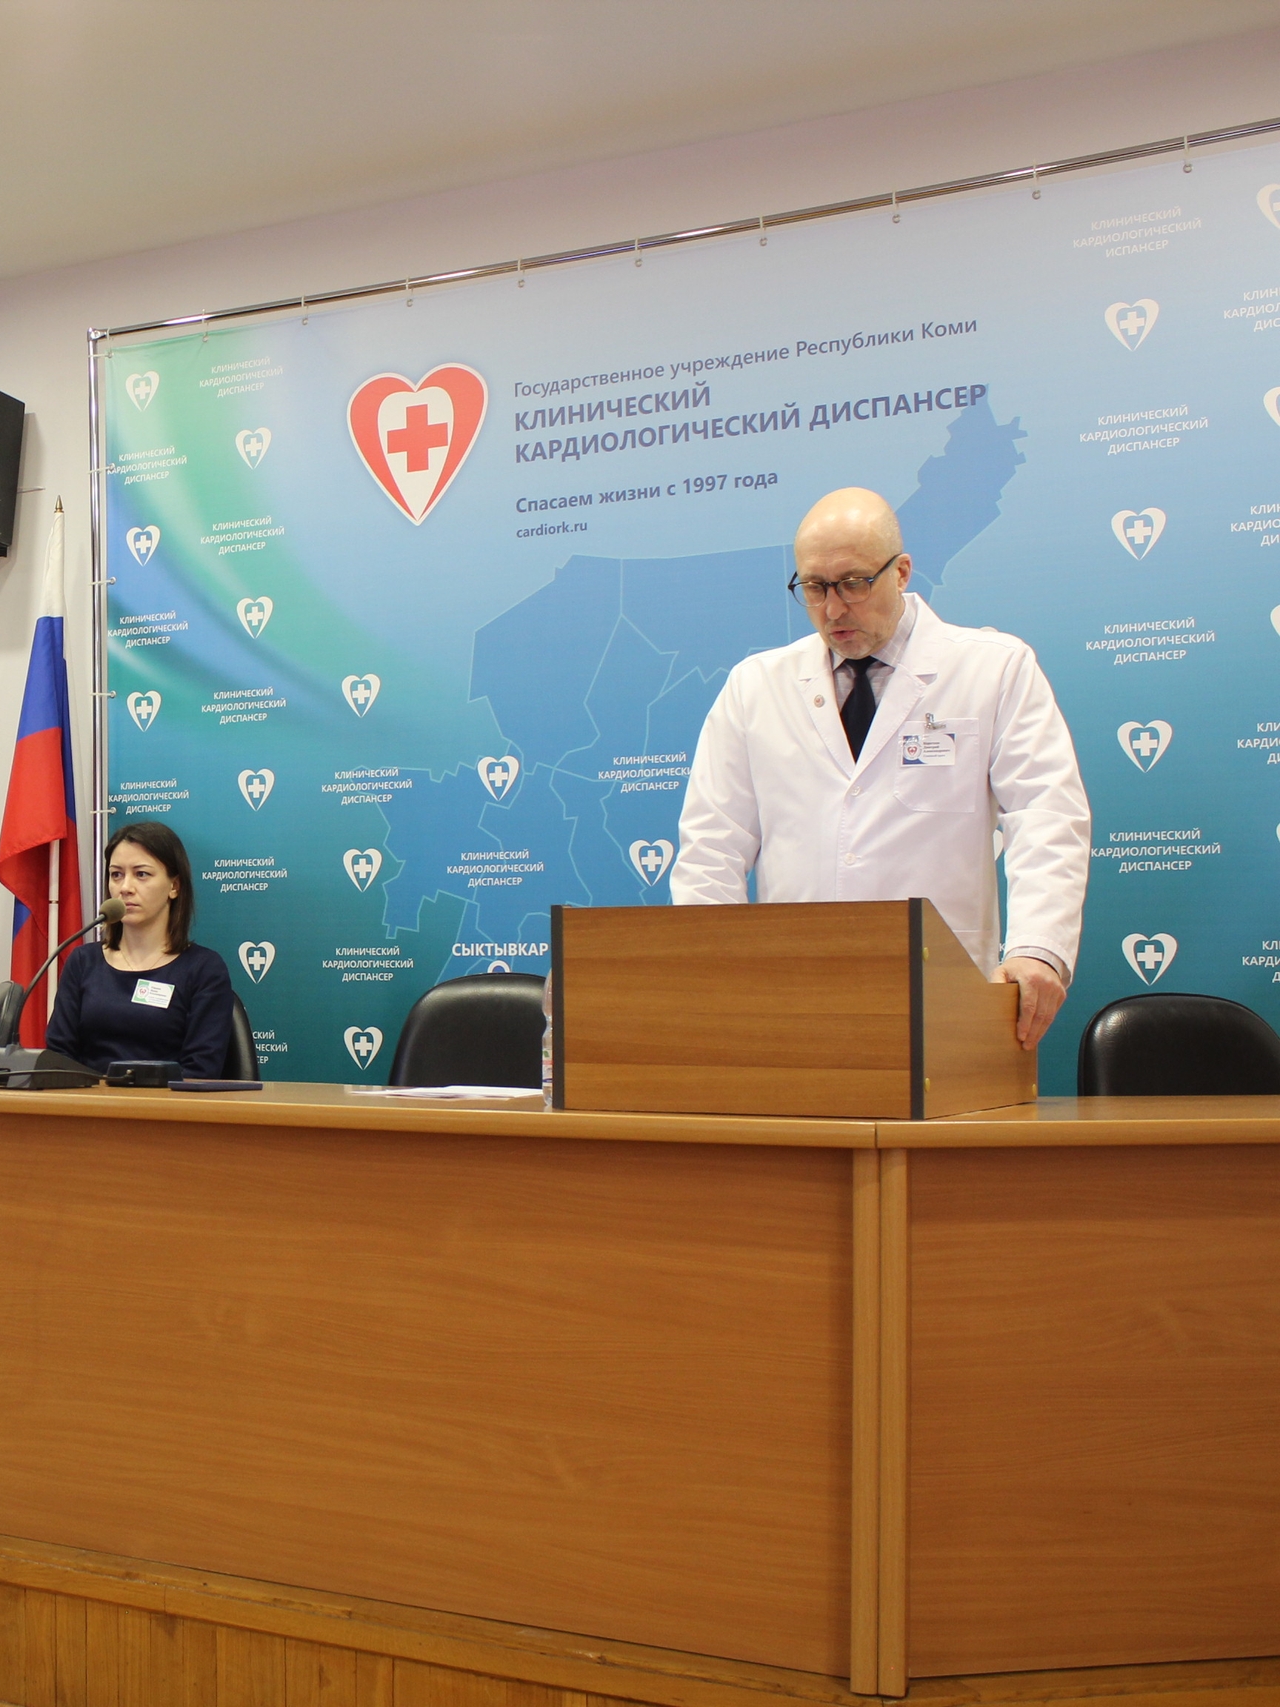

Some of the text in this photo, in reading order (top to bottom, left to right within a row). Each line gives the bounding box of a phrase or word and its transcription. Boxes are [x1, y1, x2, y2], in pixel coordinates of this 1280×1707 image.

[1091, 206, 1181, 230] КЛИНИЧЕСКИЙ
[1073, 218, 1202, 248] КАРДИОЛОГИЧЕСКИЙ
[514, 318, 977, 397] Государственное учреждение Республики Коми
[211, 357, 270, 374] КЛИНИЧЕСКИЙ
[199, 366, 283, 388] КАРДИОЛОГИЧЕСКИЙ
[217, 382, 264, 398] ДИСПАНСЕР
[515, 383, 710, 432] КЛИНИЧЕСКИЙ
[1098, 405, 1188, 426] КЛИНИЧЕСКИЙ
[515, 383, 987, 464] КАРДИОЛОГИЧЕСКИЙ ДИСПАНСЕР
[1079, 417, 1208, 442] КАРДИОЛОГИЧЕСКИЙ
[119, 446, 175, 461] КЛИНИЧЕСКИЙ
[1108, 438, 1179, 455] ДИСПАНСЕР
[124, 471, 169, 485] ДИСПАНСЕР
[516, 470, 778, 513] Спасаем жизни с 1997 года
[213, 516, 272, 531] КЛИНИЧЕСКИЙ
[516, 520, 587, 538] cardiork.ru
[200, 526, 284, 545] КАРДИОЛОГИЧЕСКИЙ
[218, 541, 265, 555] ДИСПАНСЕР
[120, 611, 176, 625] КЛИНИЧЕСКИЙ
[108, 621, 188, 637] КАРДИОЛОГИЧЕСКИЙ
[1104, 617, 1194, 634] КЛИНИЧЕСКИЙ
[125, 636, 170, 648] ДИСПАНСЕР
[1086, 631, 1215, 651] КАРДИОЛОГИЧЕСКИЙ
[1114, 650, 1186, 665] ДИСПАНСЕР
[213, 687, 273, 700] КЛИНИЧЕСКИЙ
[201, 698, 286, 714] КАРДИОЛОГИЧЕСКИЙ
[220, 712, 267, 725] ДИСПАНСЕР
[613, 752, 686, 765] КЛИНИЧЕСКИЙ
[334, 768, 398, 780] КЛИНИЧЕСКИЙ
[598, 768, 692, 780] КАРДИОЛОГИЧЕСКИ
[120, 778, 177, 791] КЛИНИЧЕСКИЙ
[322, 779, 412, 793] КАРДИОЛОГИЧЕСКИЙ
[621, 782, 679, 793] ДИСПАНСЕР
[109, 790, 189, 803] КАРДИОЛОГИЧЕСКИЙ
[341, 793, 392, 805] ДИСПАНСЕР
[126, 803, 171, 815] ДИСПАНСЕР
[1109, 828, 1200, 842] КЛИНИЧЕСКИЙ
[461, 849, 529, 862] КЛИНИЧЕСКИЙ
[1091, 843, 1220, 858] КАРДИОЛОГИЧЕСКИЙ
[215, 857, 274, 868] КЛИНИЧЕСКИЙ
[447, 862, 543, 875] КАРДИОЛОГИЧЕСКИЙ
[1119, 860, 1191, 873] ДИСПАНСЕР
[202, 869, 287, 881] КАРДИОЛОГИЧЕСКИЙ
[468, 875, 522, 888] ДИСПАНСЕР
[220, 882, 268, 893] ДИСПАНСЕР
[336, 946, 399, 957] КЛИНИЧЕСКИЙ
[452, 943, 548, 957] СЫКТЫВКАР
[322, 958, 413, 970] КАРДИОЛОГИЧЕСКИЙ
[342, 971, 393, 983] ДИСПАНСЕР
